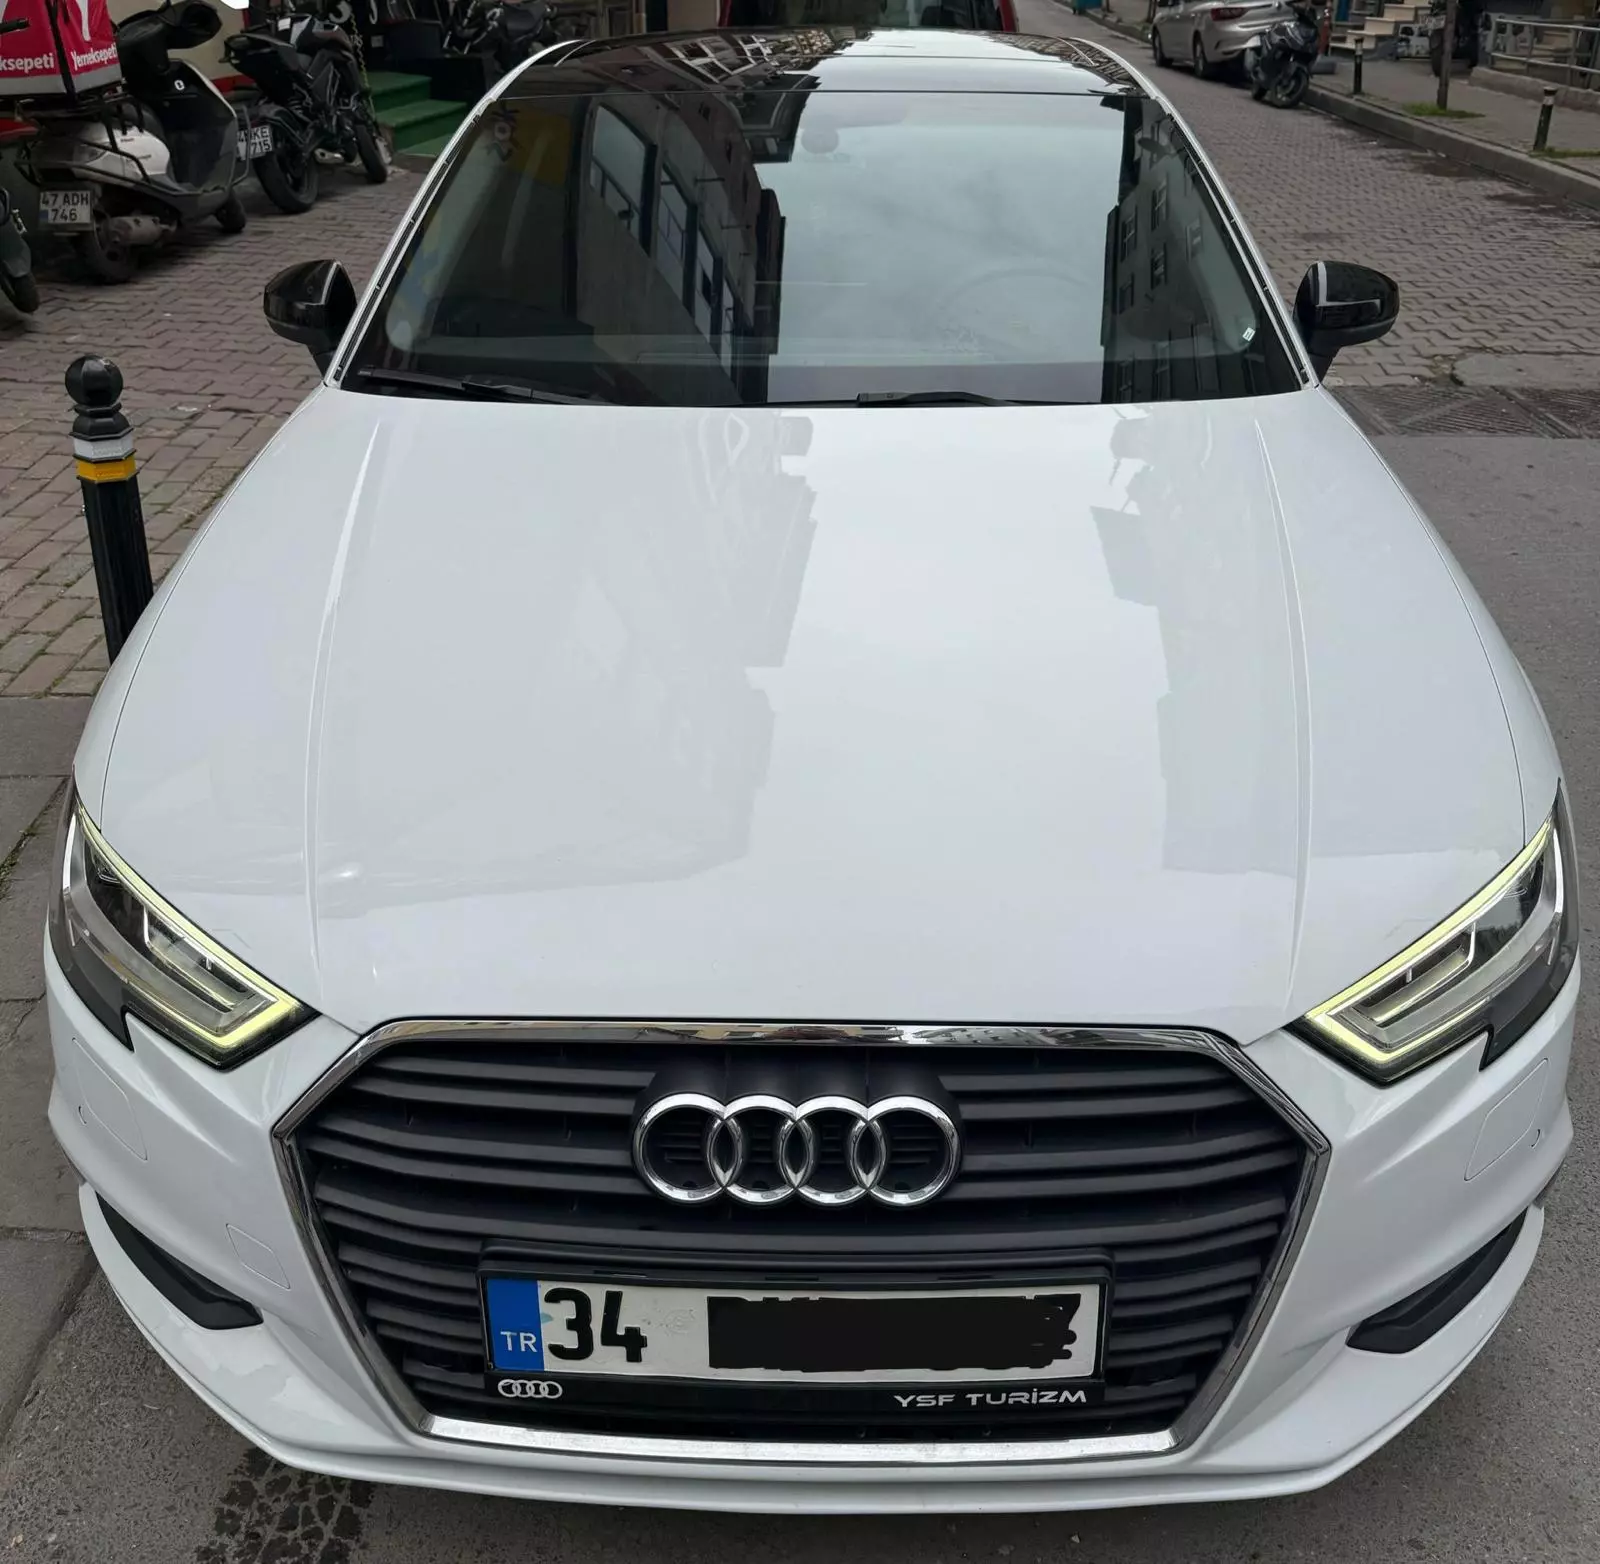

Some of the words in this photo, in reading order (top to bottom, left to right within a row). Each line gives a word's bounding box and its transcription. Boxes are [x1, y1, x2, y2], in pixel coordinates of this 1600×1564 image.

[41, 193, 59, 206] 47
[62, 192, 89, 206] ADH
[51, 208, 78, 222] 746
[544, 1287, 648, 1363] 34
[500, 1331, 538, 1353] TR
[894, 1394, 955, 1407] YSF
[965, 1388, 1087, 1405] TURİZM
